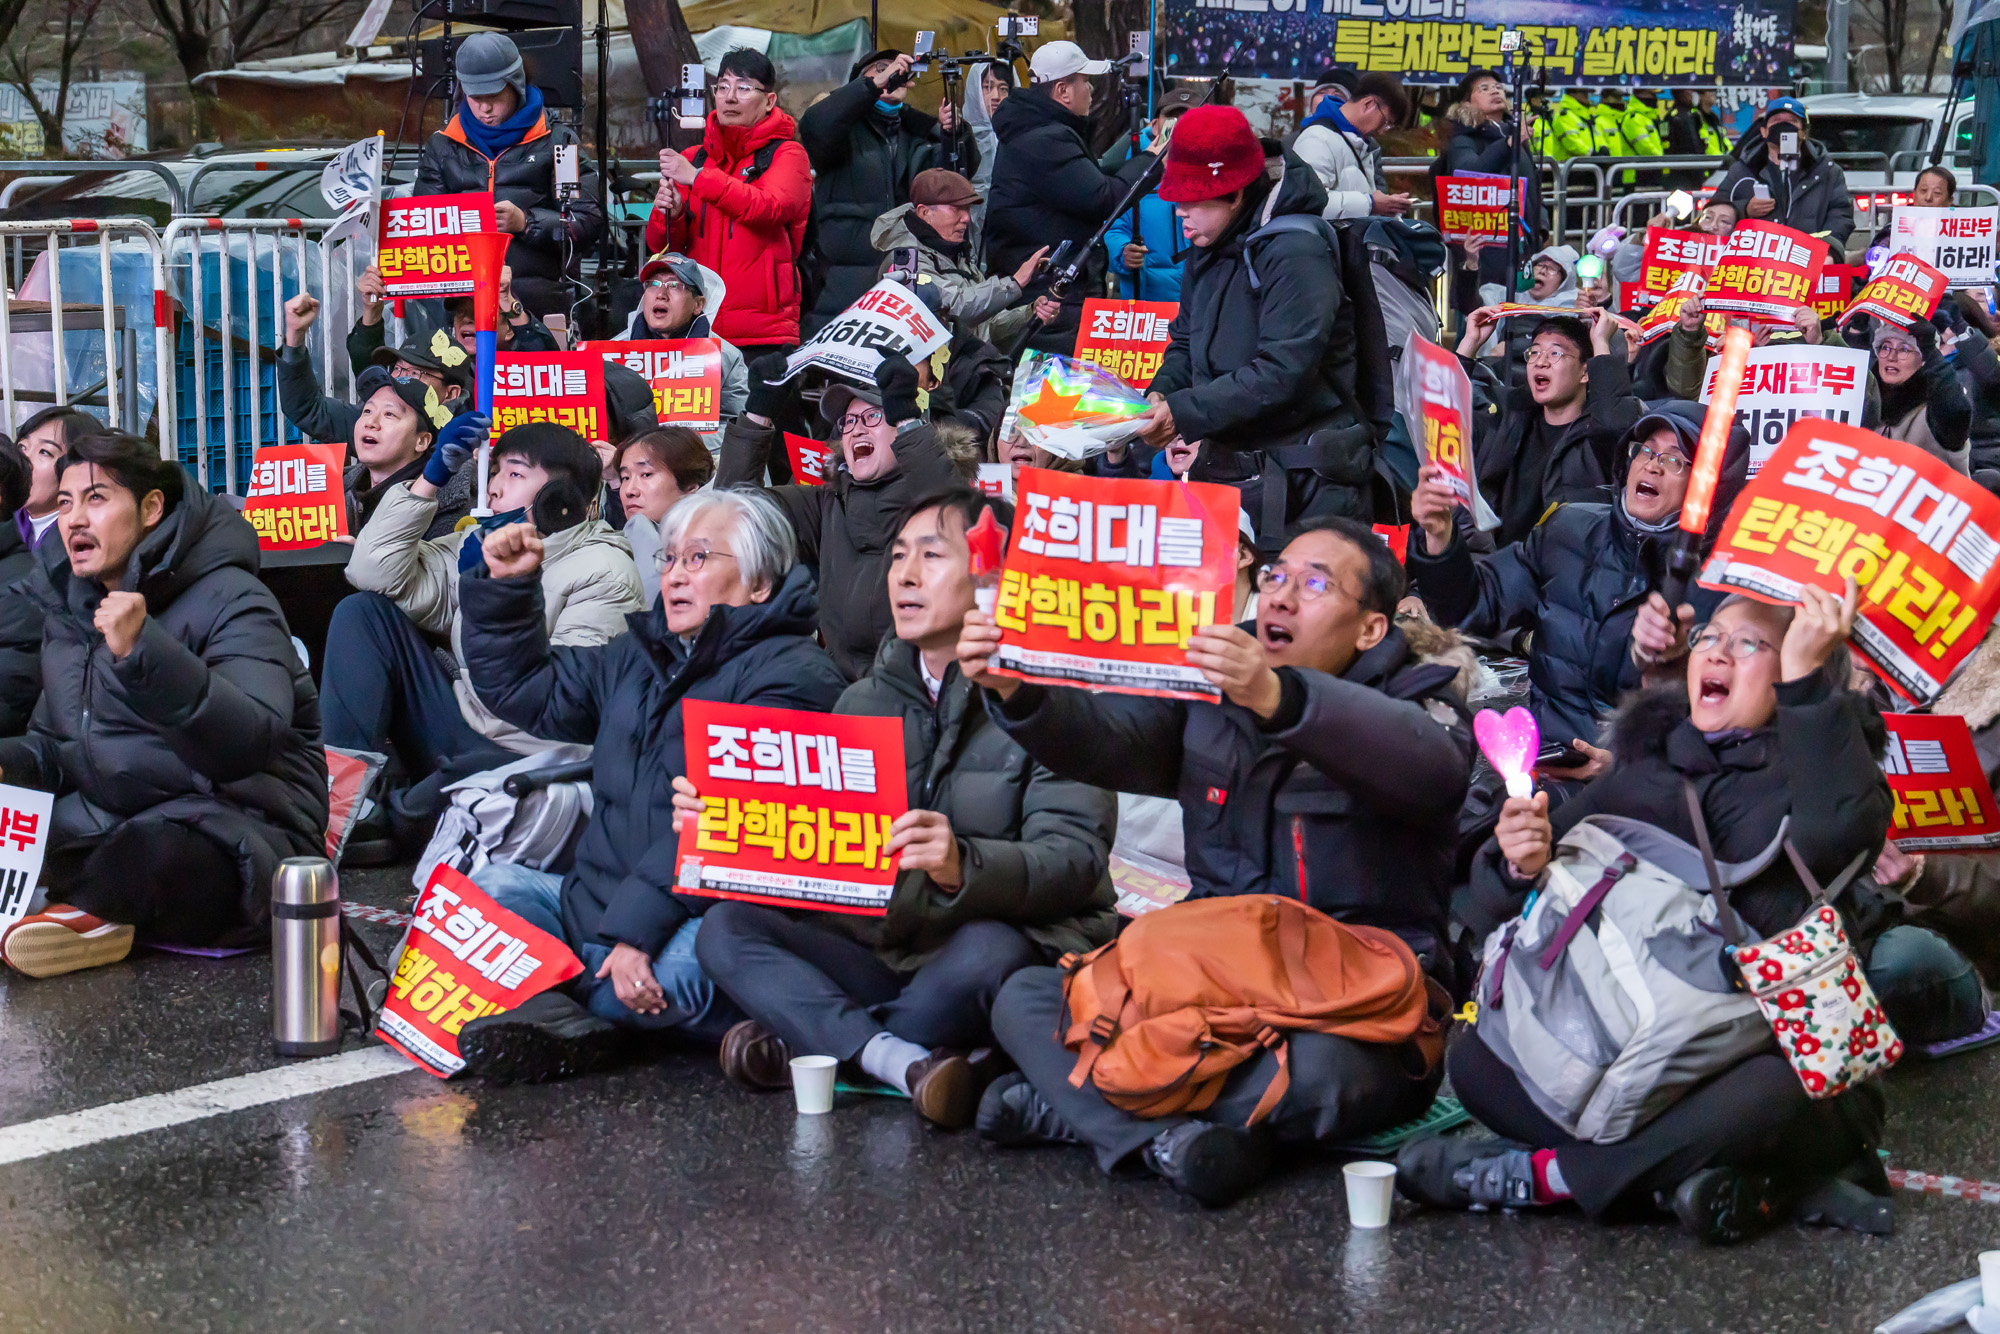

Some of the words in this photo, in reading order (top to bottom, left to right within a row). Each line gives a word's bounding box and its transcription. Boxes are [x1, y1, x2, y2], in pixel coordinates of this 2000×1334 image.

[1335, 20, 1505, 73] 특별재판부
[1583, 25, 1717, 76] 설치하라!
[1447, 184, 1510, 206] 조희대를
[386, 206, 482, 238] 조희대를
[1706, 264, 1811, 303] 탄핵하라!
[846, 290, 936, 343] 재판부
[1090, 310, 1169, 342] 조희대를
[652, 387, 712, 416] 하라!
[1707, 362, 1855, 396] 별재판부
[242, 505, 338, 543] 핵하라!
[1018, 492, 1203, 567] 조희대를
[1782, 438, 2000, 583] 조희대를
[1730, 496, 1978, 660] 탄핵하라!
[707, 724, 876, 793] 조희대를
[696, 795, 892, 871] 탄핵하라!
[413, 883, 542, 991] 조희대를
